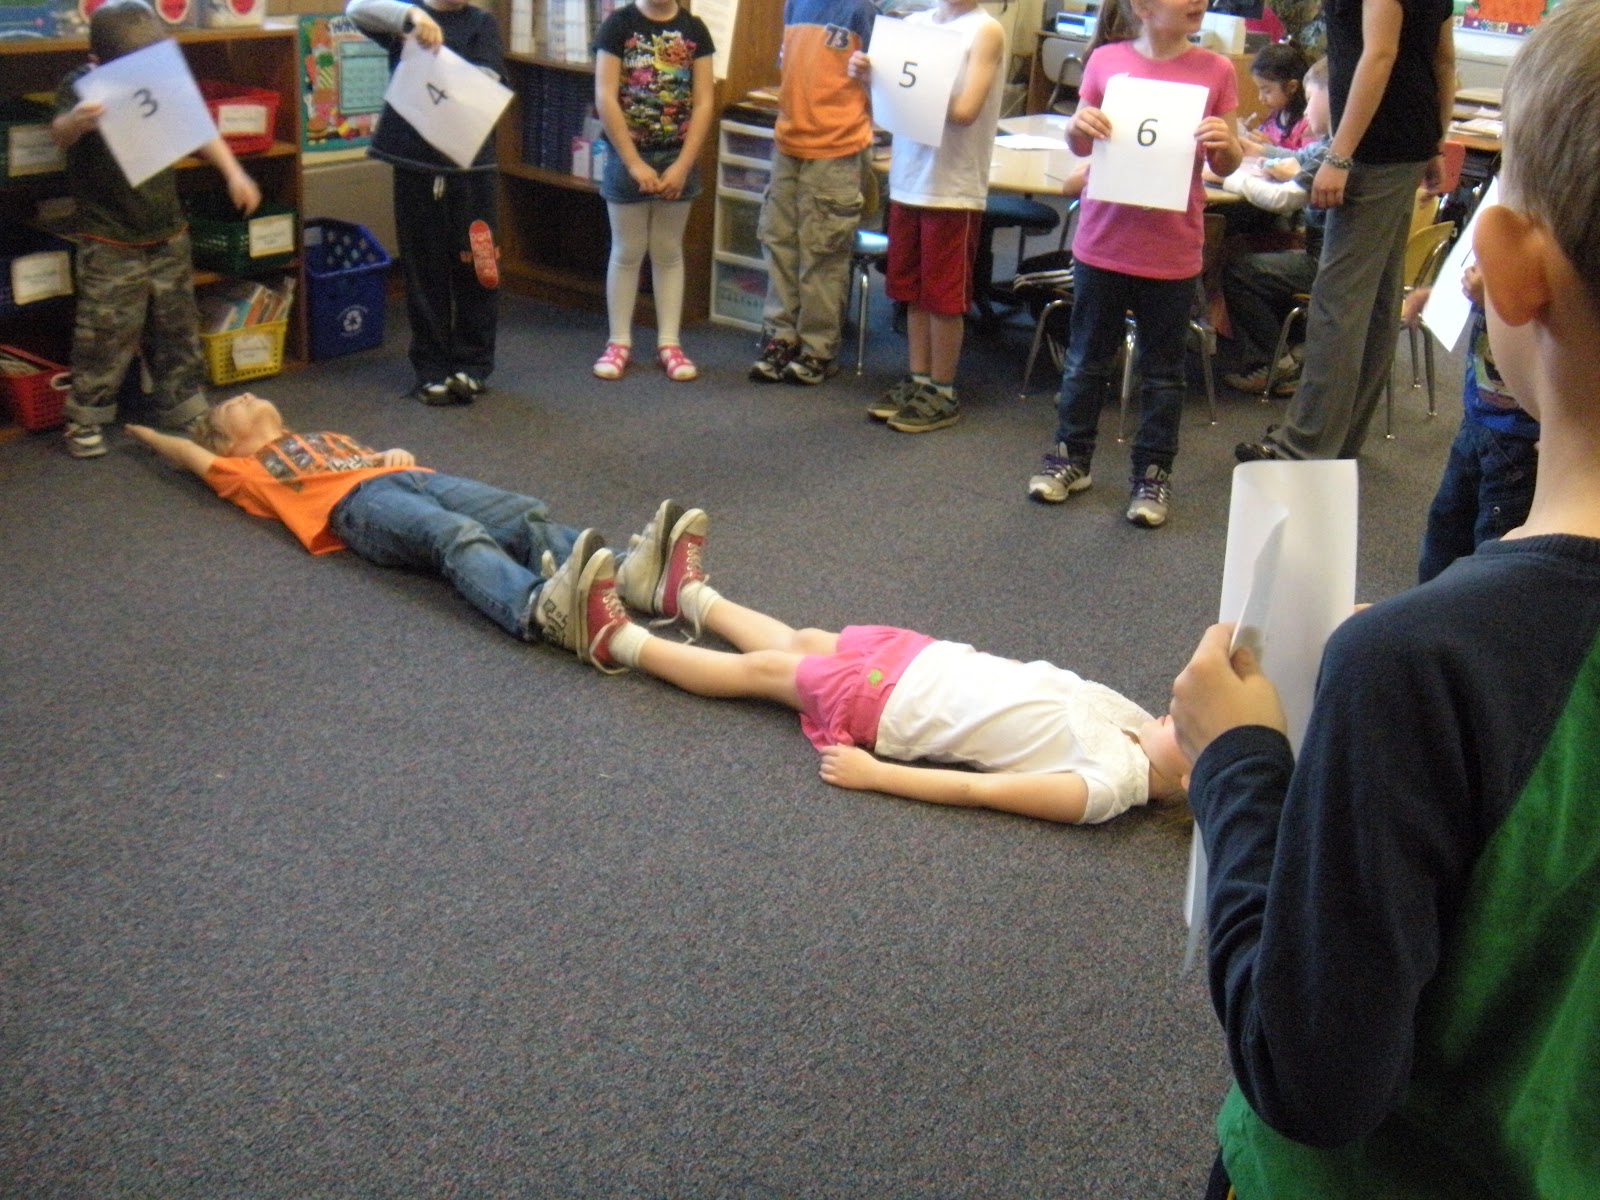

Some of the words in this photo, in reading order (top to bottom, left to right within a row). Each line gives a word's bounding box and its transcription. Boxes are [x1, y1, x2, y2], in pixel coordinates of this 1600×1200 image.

[825, 24, 849, 48] 73
[899, 61, 918, 88] 5
[134, 89, 158, 118] 3
[427, 82, 448, 105] 4
[1137, 118, 1158, 147] 6
